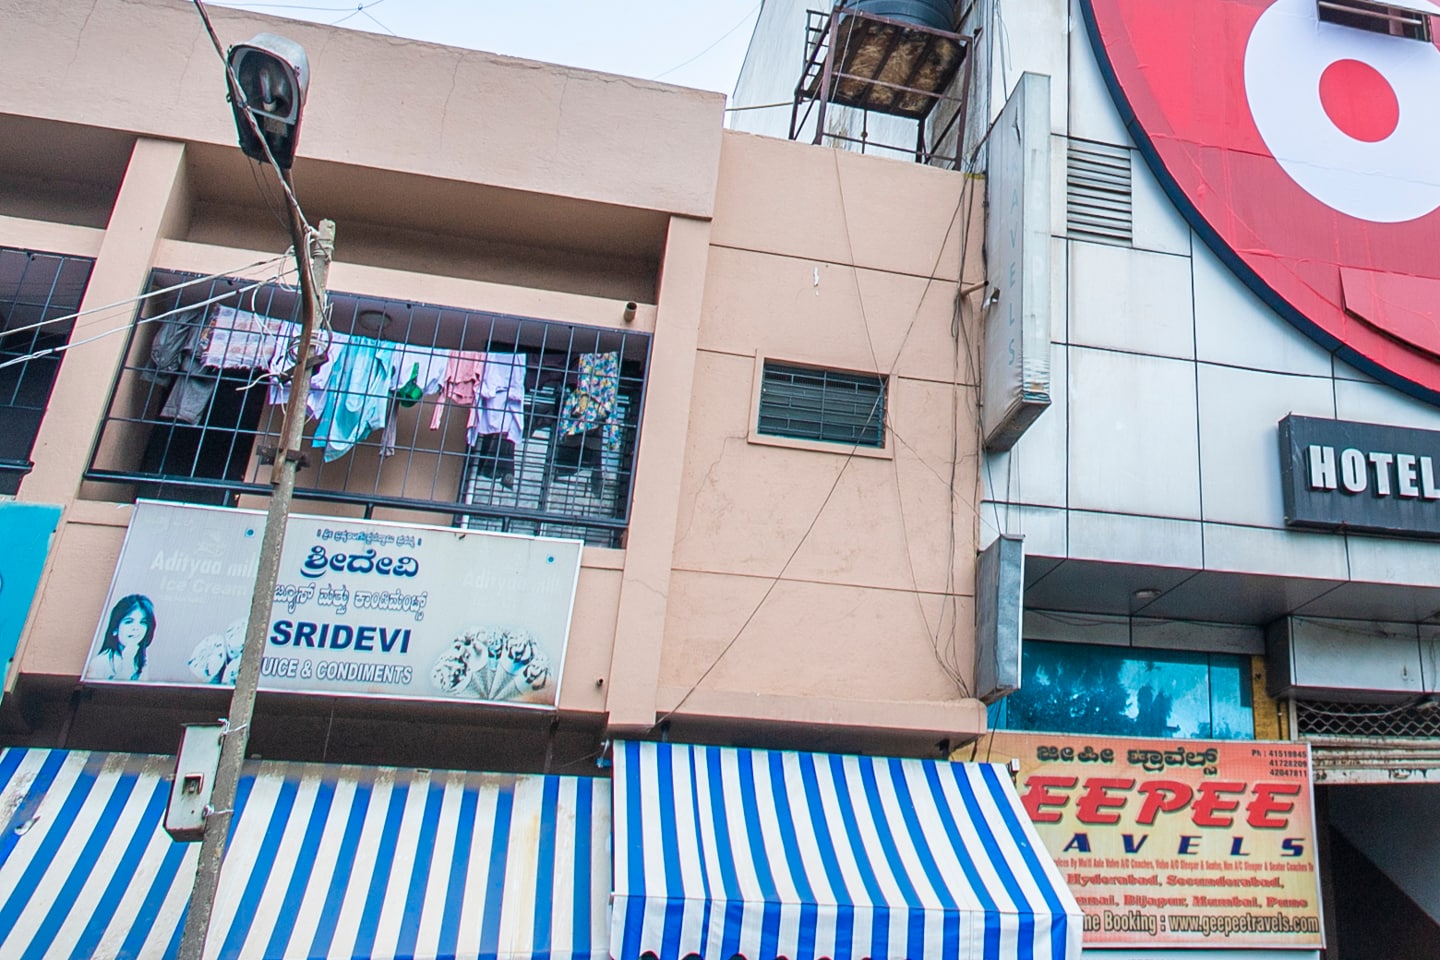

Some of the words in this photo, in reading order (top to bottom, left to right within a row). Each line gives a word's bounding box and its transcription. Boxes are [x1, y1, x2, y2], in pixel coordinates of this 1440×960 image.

[1306, 444, 1440, 500] HOTEL
[301, 545, 419, 578] ಶ್ರೀದೇವಿ
[270, 619, 412, 654] SRIDEVI
[261, 656, 299, 678] UICE
[301, 659, 312, 678] &
[316, 661, 413, 685] CONDIMENTS
[1251, 749, 1262, 757] Ph
[1021, 775, 1301, 829] EEPEE
[1063, 833, 1306, 857] AVELS
[1067, 873, 1162, 886] Hyderabad,
[1166, 874, 1284, 888] Secunderabad,
[1123, 894, 1188, 908] Bijapur,
[1192, 895, 1262, 908] Mumbai,
[1266, 896, 1308, 908] Pune
[1104, 911, 1157, 936] Booking
[1168, 912, 1320, 937] www.geepeetravels.com
